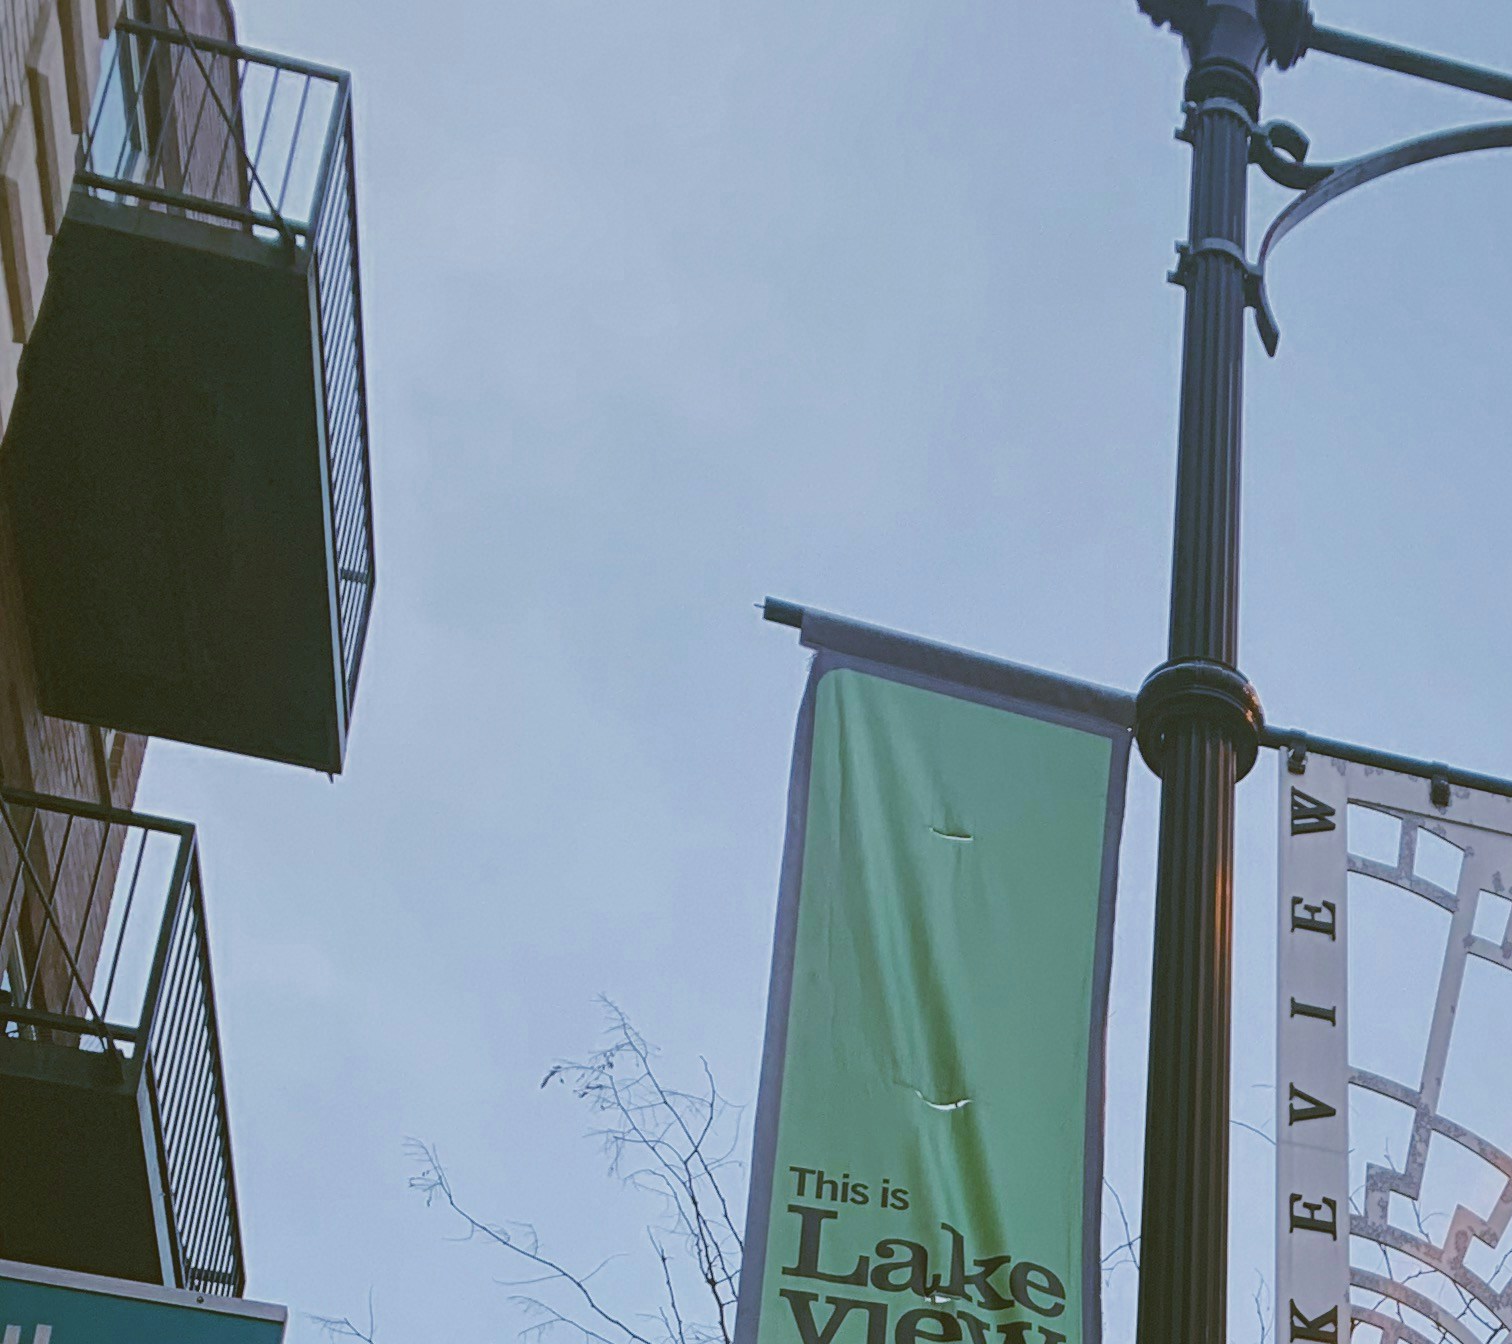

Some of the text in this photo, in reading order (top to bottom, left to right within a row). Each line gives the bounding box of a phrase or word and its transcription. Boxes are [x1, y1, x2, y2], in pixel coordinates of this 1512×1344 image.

[788, 1166, 910, 1211] This is
[780, 1203, 1067, 1317] Lake
